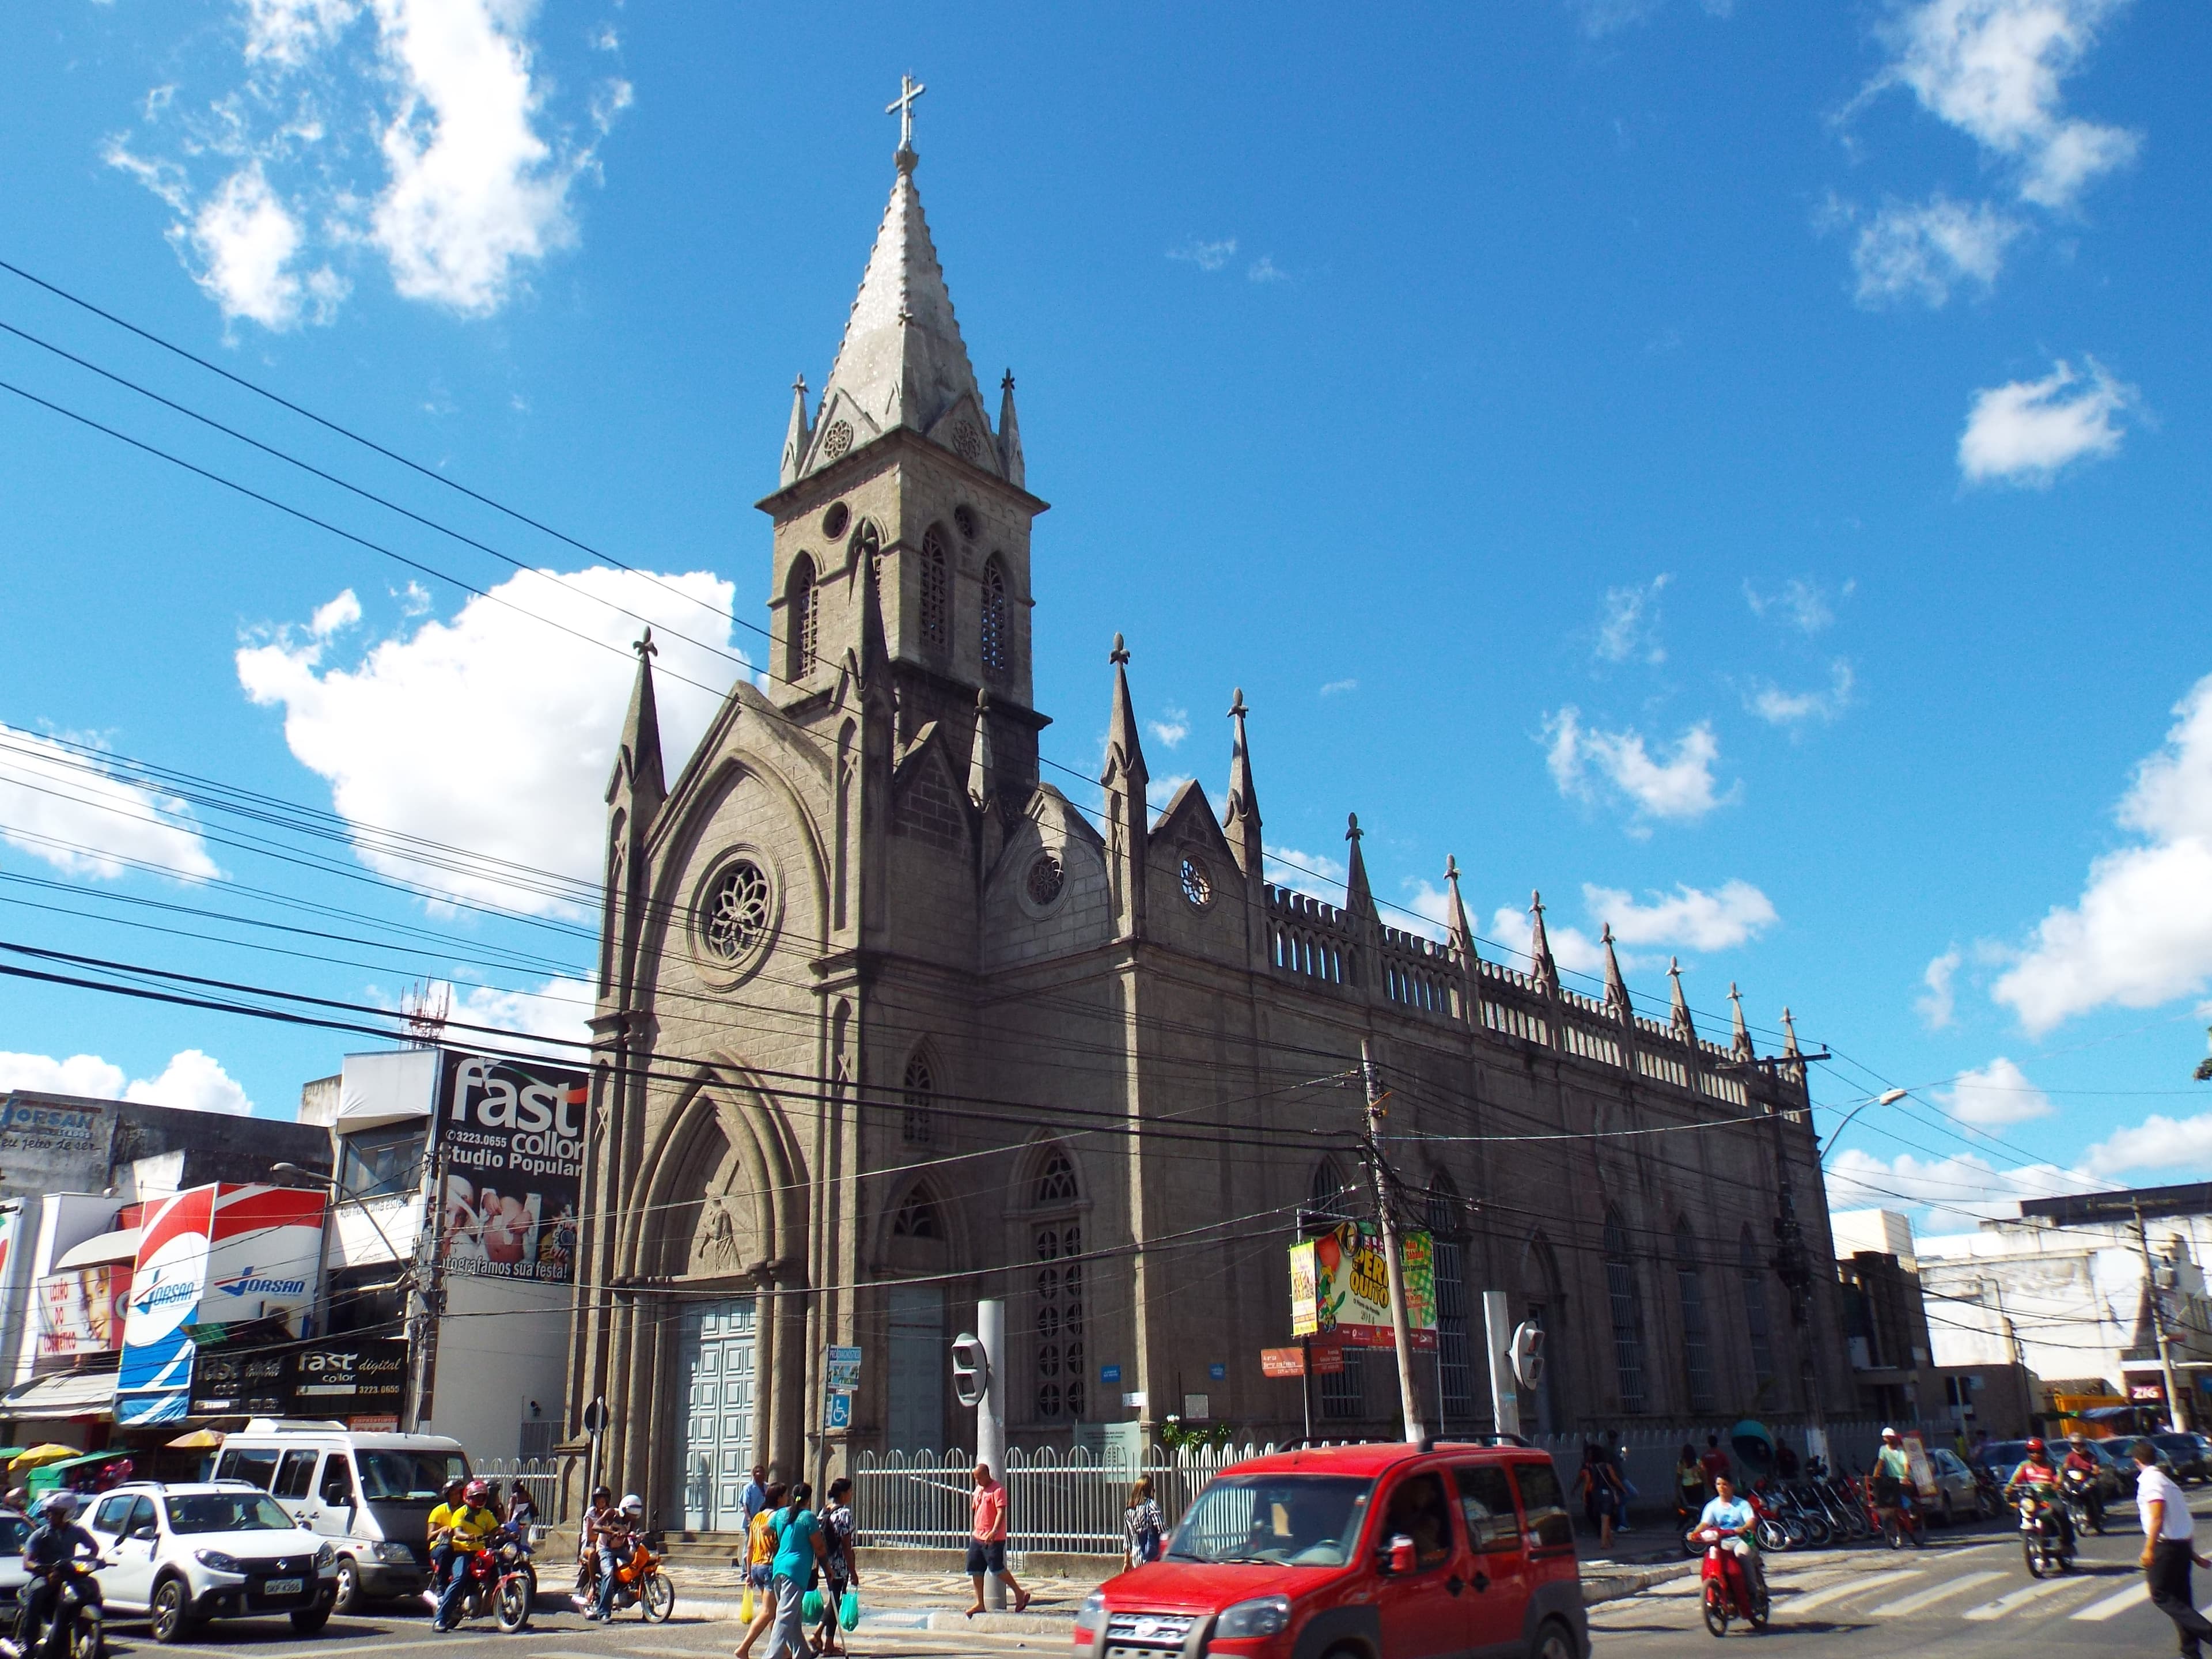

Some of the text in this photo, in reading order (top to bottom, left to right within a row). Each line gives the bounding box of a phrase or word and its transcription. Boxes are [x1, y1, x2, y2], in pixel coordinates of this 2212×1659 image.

[452, 1058, 588, 1137] fast
[56, 1138, 71, 1150] de
[456, 1132, 507, 1147] 3223.0655
[448, 1145, 582, 1176] tudio Popular
[513, 1263, 532, 1277] sua
[1350, 1270, 1389, 1309] QUITO
[359, 1358, 402, 1375] digital
